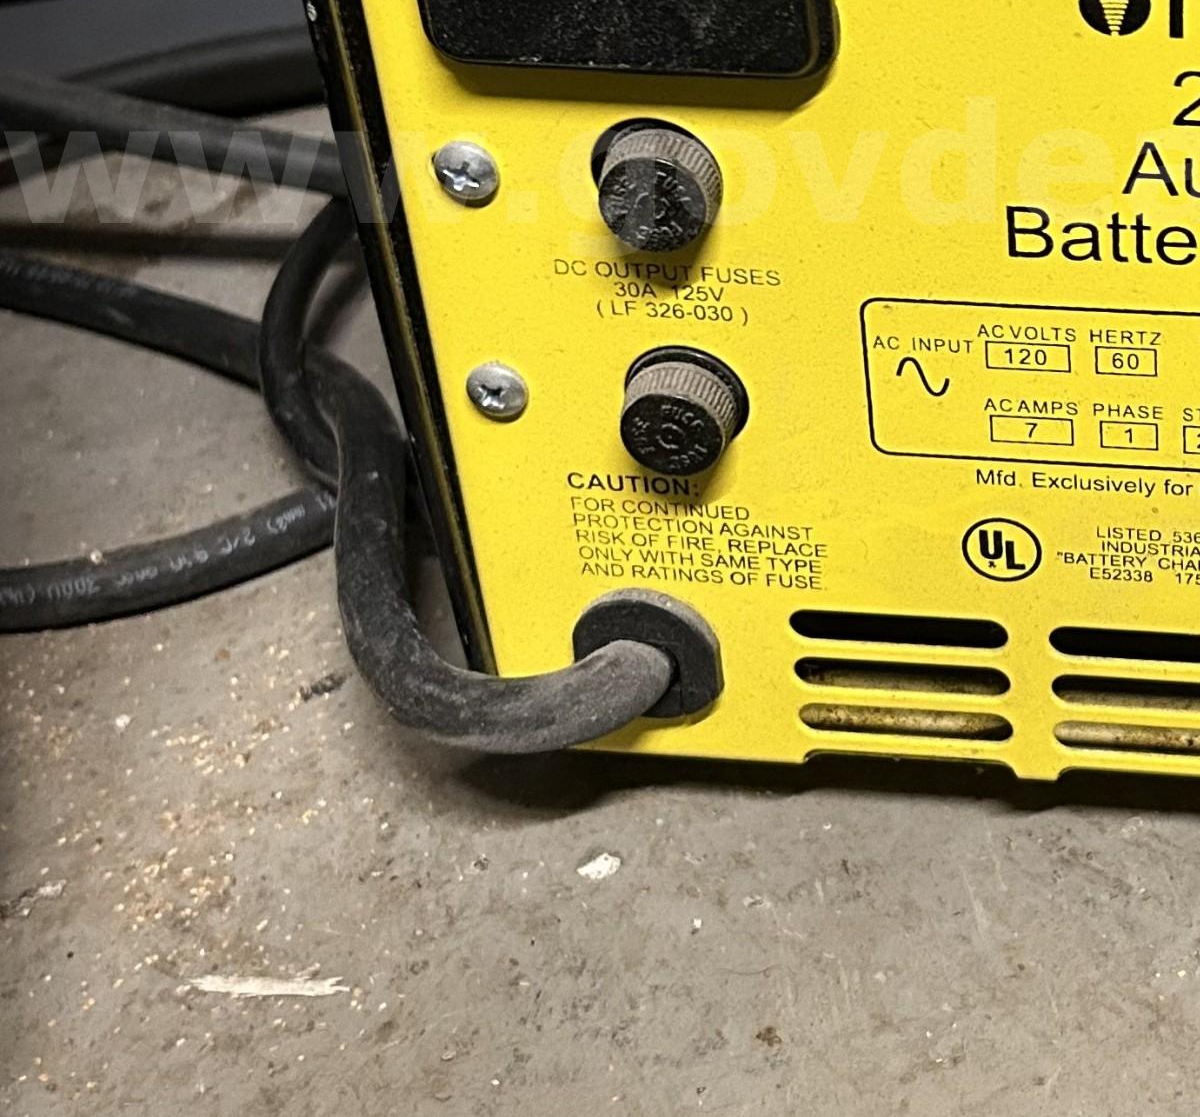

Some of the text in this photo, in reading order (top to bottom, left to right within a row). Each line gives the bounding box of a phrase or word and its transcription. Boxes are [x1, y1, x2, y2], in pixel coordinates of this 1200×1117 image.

[553, 258, 782, 287] DC OUTPUT FUSES
[614, 281, 726, 303] 30A 125V
[645, 302, 734, 323] 326-030
[976, 323, 1078, 343] AC VOLTS
[1088, 328, 1163, 346] HERTZ
[872, 335, 975, 356] AC INPUT
[1003, 348, 1048, 367] 120
[1111, 353, 1141, 371] 60
[983, 397, 1080, 416] AC AMPS
[1092, 402, 1164, 420] PHASE
[1026, 422, 1038, 439] 7
[1124, 427, 1134, 444] 1
[566, 471, 701, 498] CAUTION:
[1032, 471, 1157, 499] Exclusively
[1163, 479, 1194, 498] for
[570, 496, 751, 522] FOR CONTINUED
[572, 513, 815, 542] PROTECTION AGAINST
[1095, 525, 1163, 543] LISTED
[575, 529, 626, 547] RISK
[630, 532, 658, 548] OF
[727, 538, 829, 559] REPLACE
[977, 529, 1027, 571] UL
[578, 545, 824, 575] ONLY WITH SAME TYPE
[581, 561, 625, 579] AND
[630, 563, 725, 585] RATINGS
[729, 570, 759, 587] OF
[1089, 567, 1154, 584] E52338
